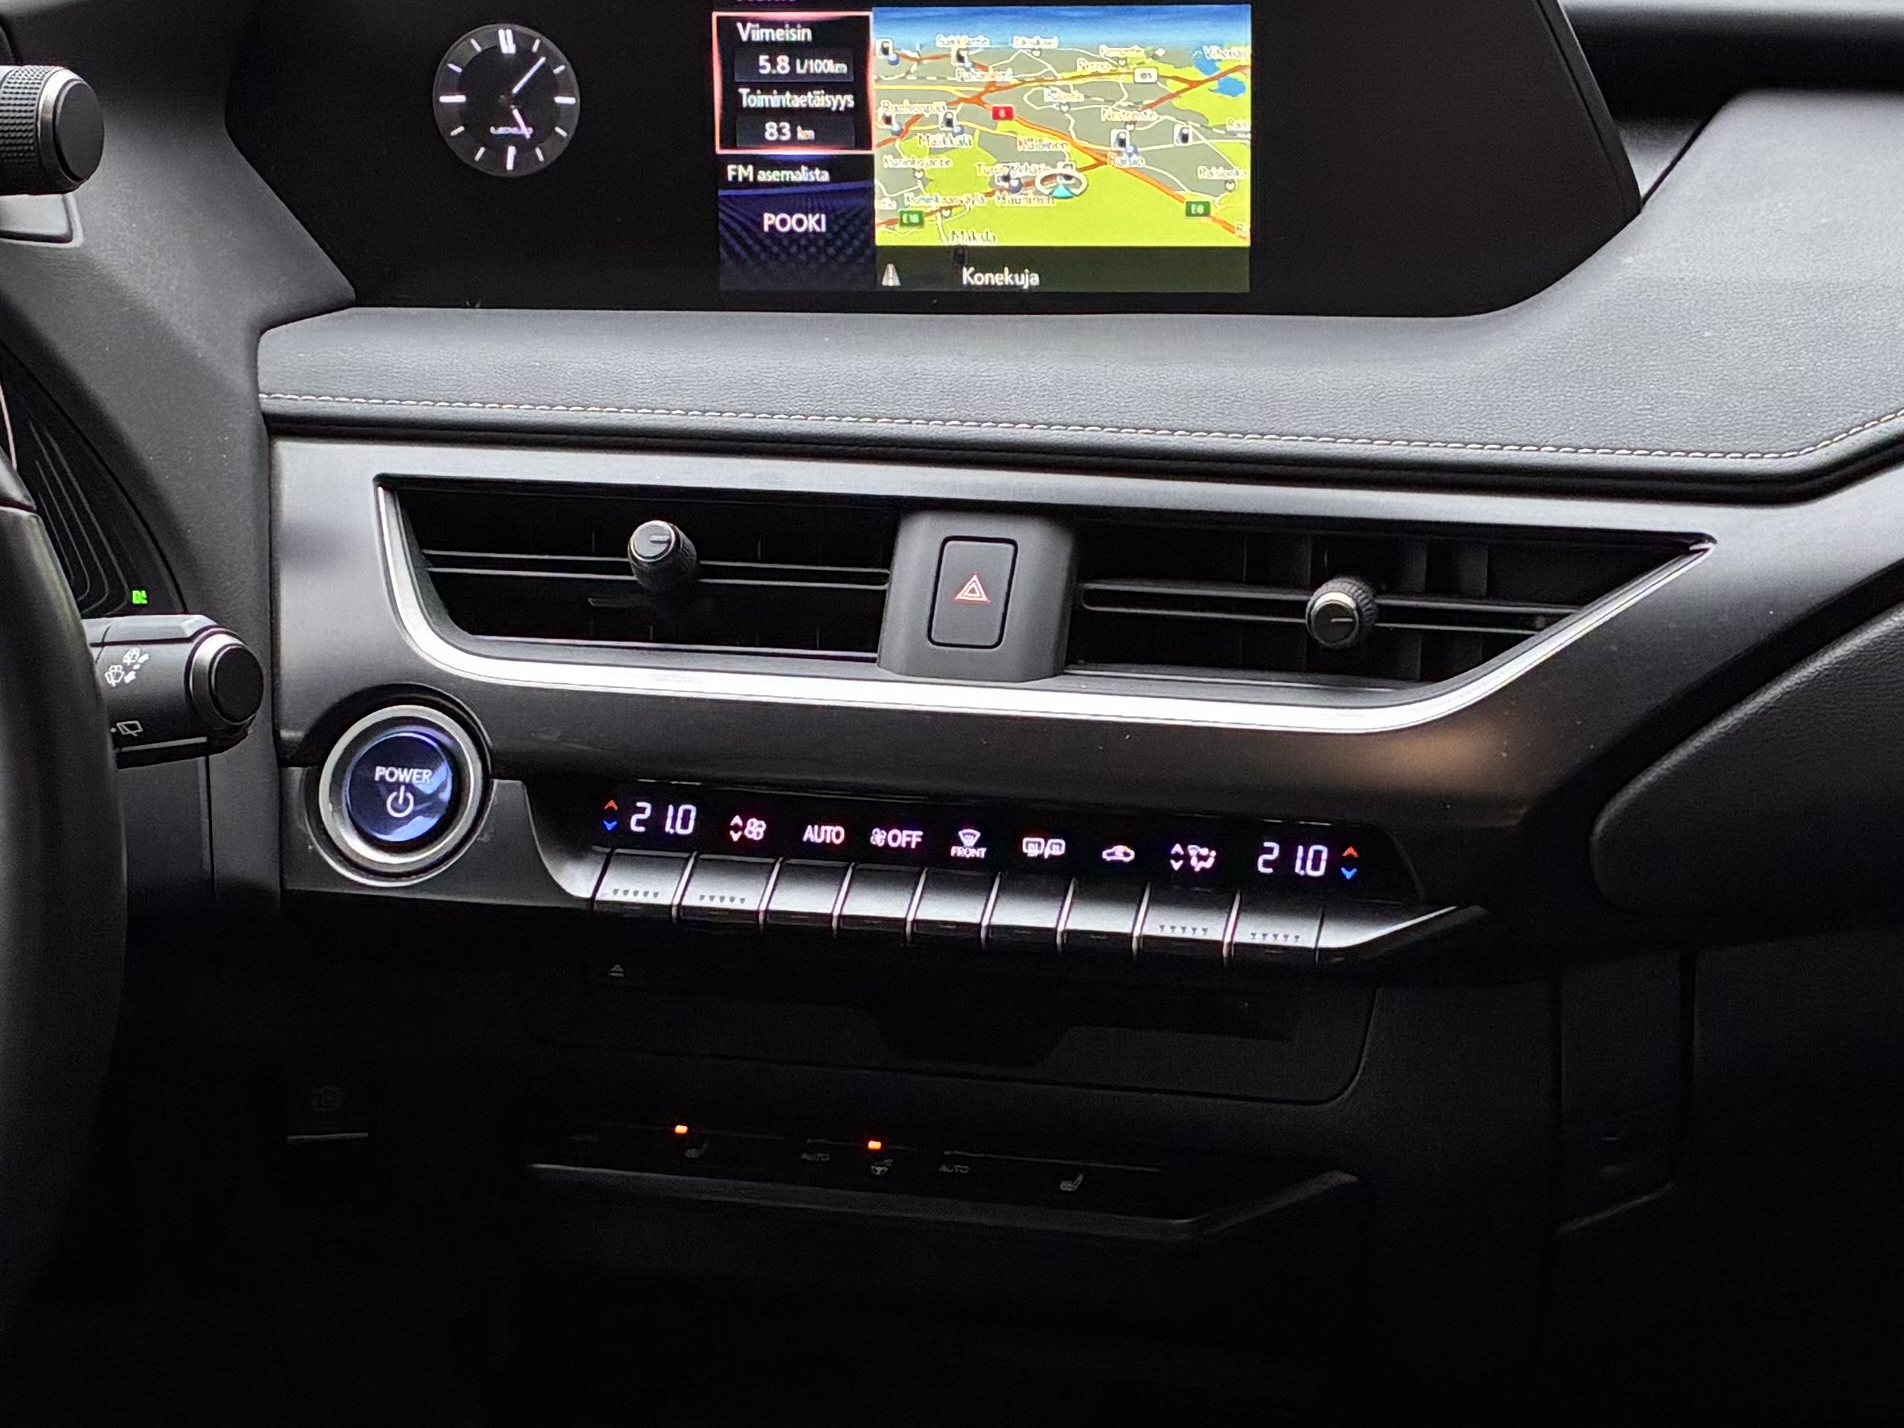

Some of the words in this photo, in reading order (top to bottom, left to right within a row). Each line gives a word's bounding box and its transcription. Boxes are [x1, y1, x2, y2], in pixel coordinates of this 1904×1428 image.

[736, 22, 813, 43] Viimeisin
[758, 55, 790, 74] 5.8
[738, 87, 855, 112] Toimintaetäisyys
[764, 122, 792, 141] 83
[797, 126, 815, 141] km
[727, 165, 754, 182] FM
[757, 166, 831, 183] asemalista
[763, 213, 828, 234] POOKI
[962, 266, 1041, 290] Konekuja
[374, 766, 434, 784] POWER
[629, 801, 697, 836] 21.0
[803, 824, 845, 844] AUTO
[887, 828, 924, 848] OFF
[950, 846, 987, 858] FRONT
[1257, 841, 1329, 877] 21.0
